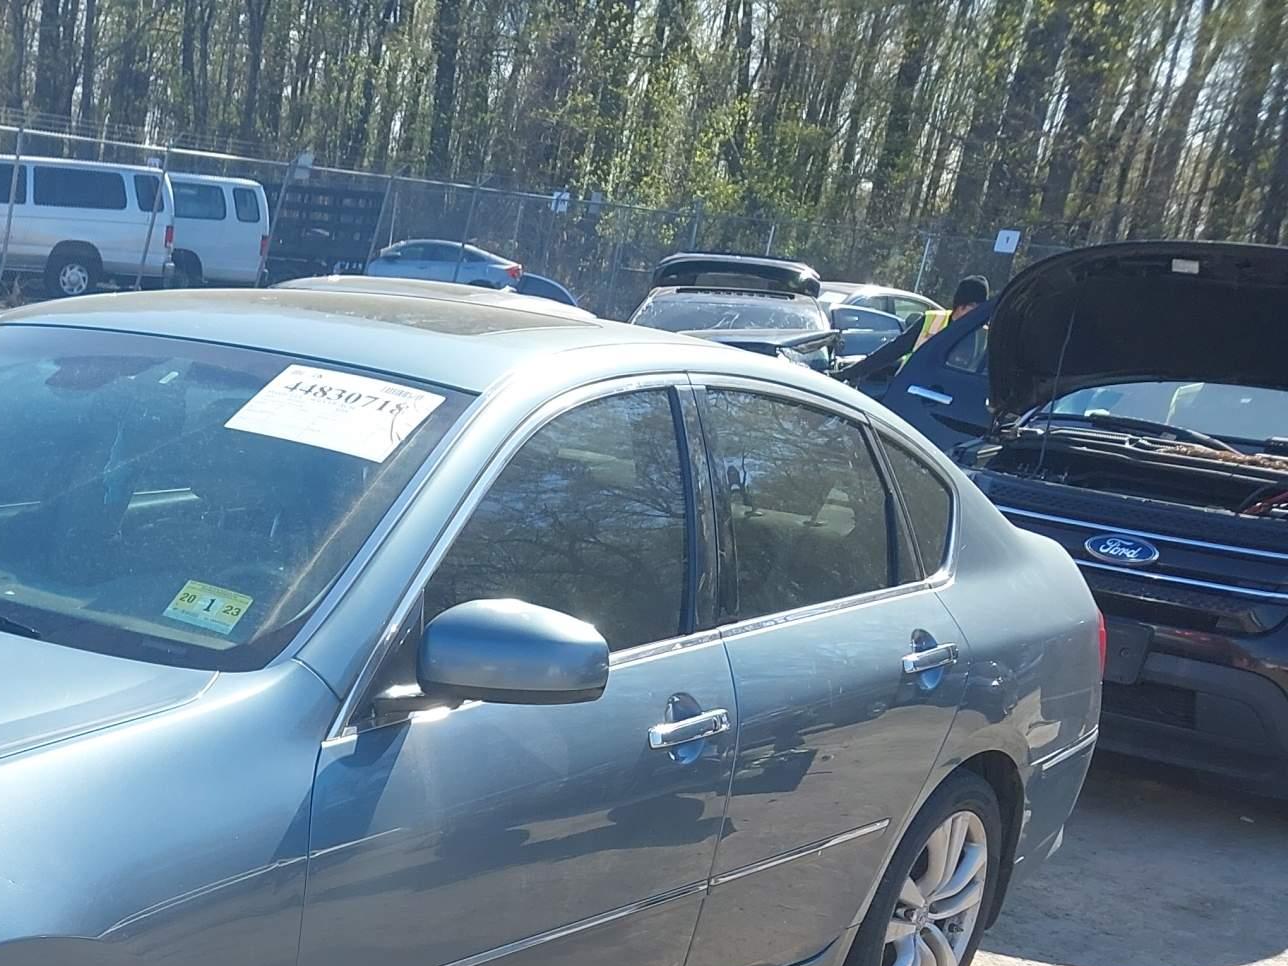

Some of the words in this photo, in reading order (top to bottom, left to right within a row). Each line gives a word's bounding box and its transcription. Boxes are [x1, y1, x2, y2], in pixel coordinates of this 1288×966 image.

[283, 380, 410, 415] 44830718
[1098, 537, 1141, 558] Ford
[179, 592, 197, 604] 20
[203, 598, 217, 612] 1
[222, 605, 241, 617] 23
